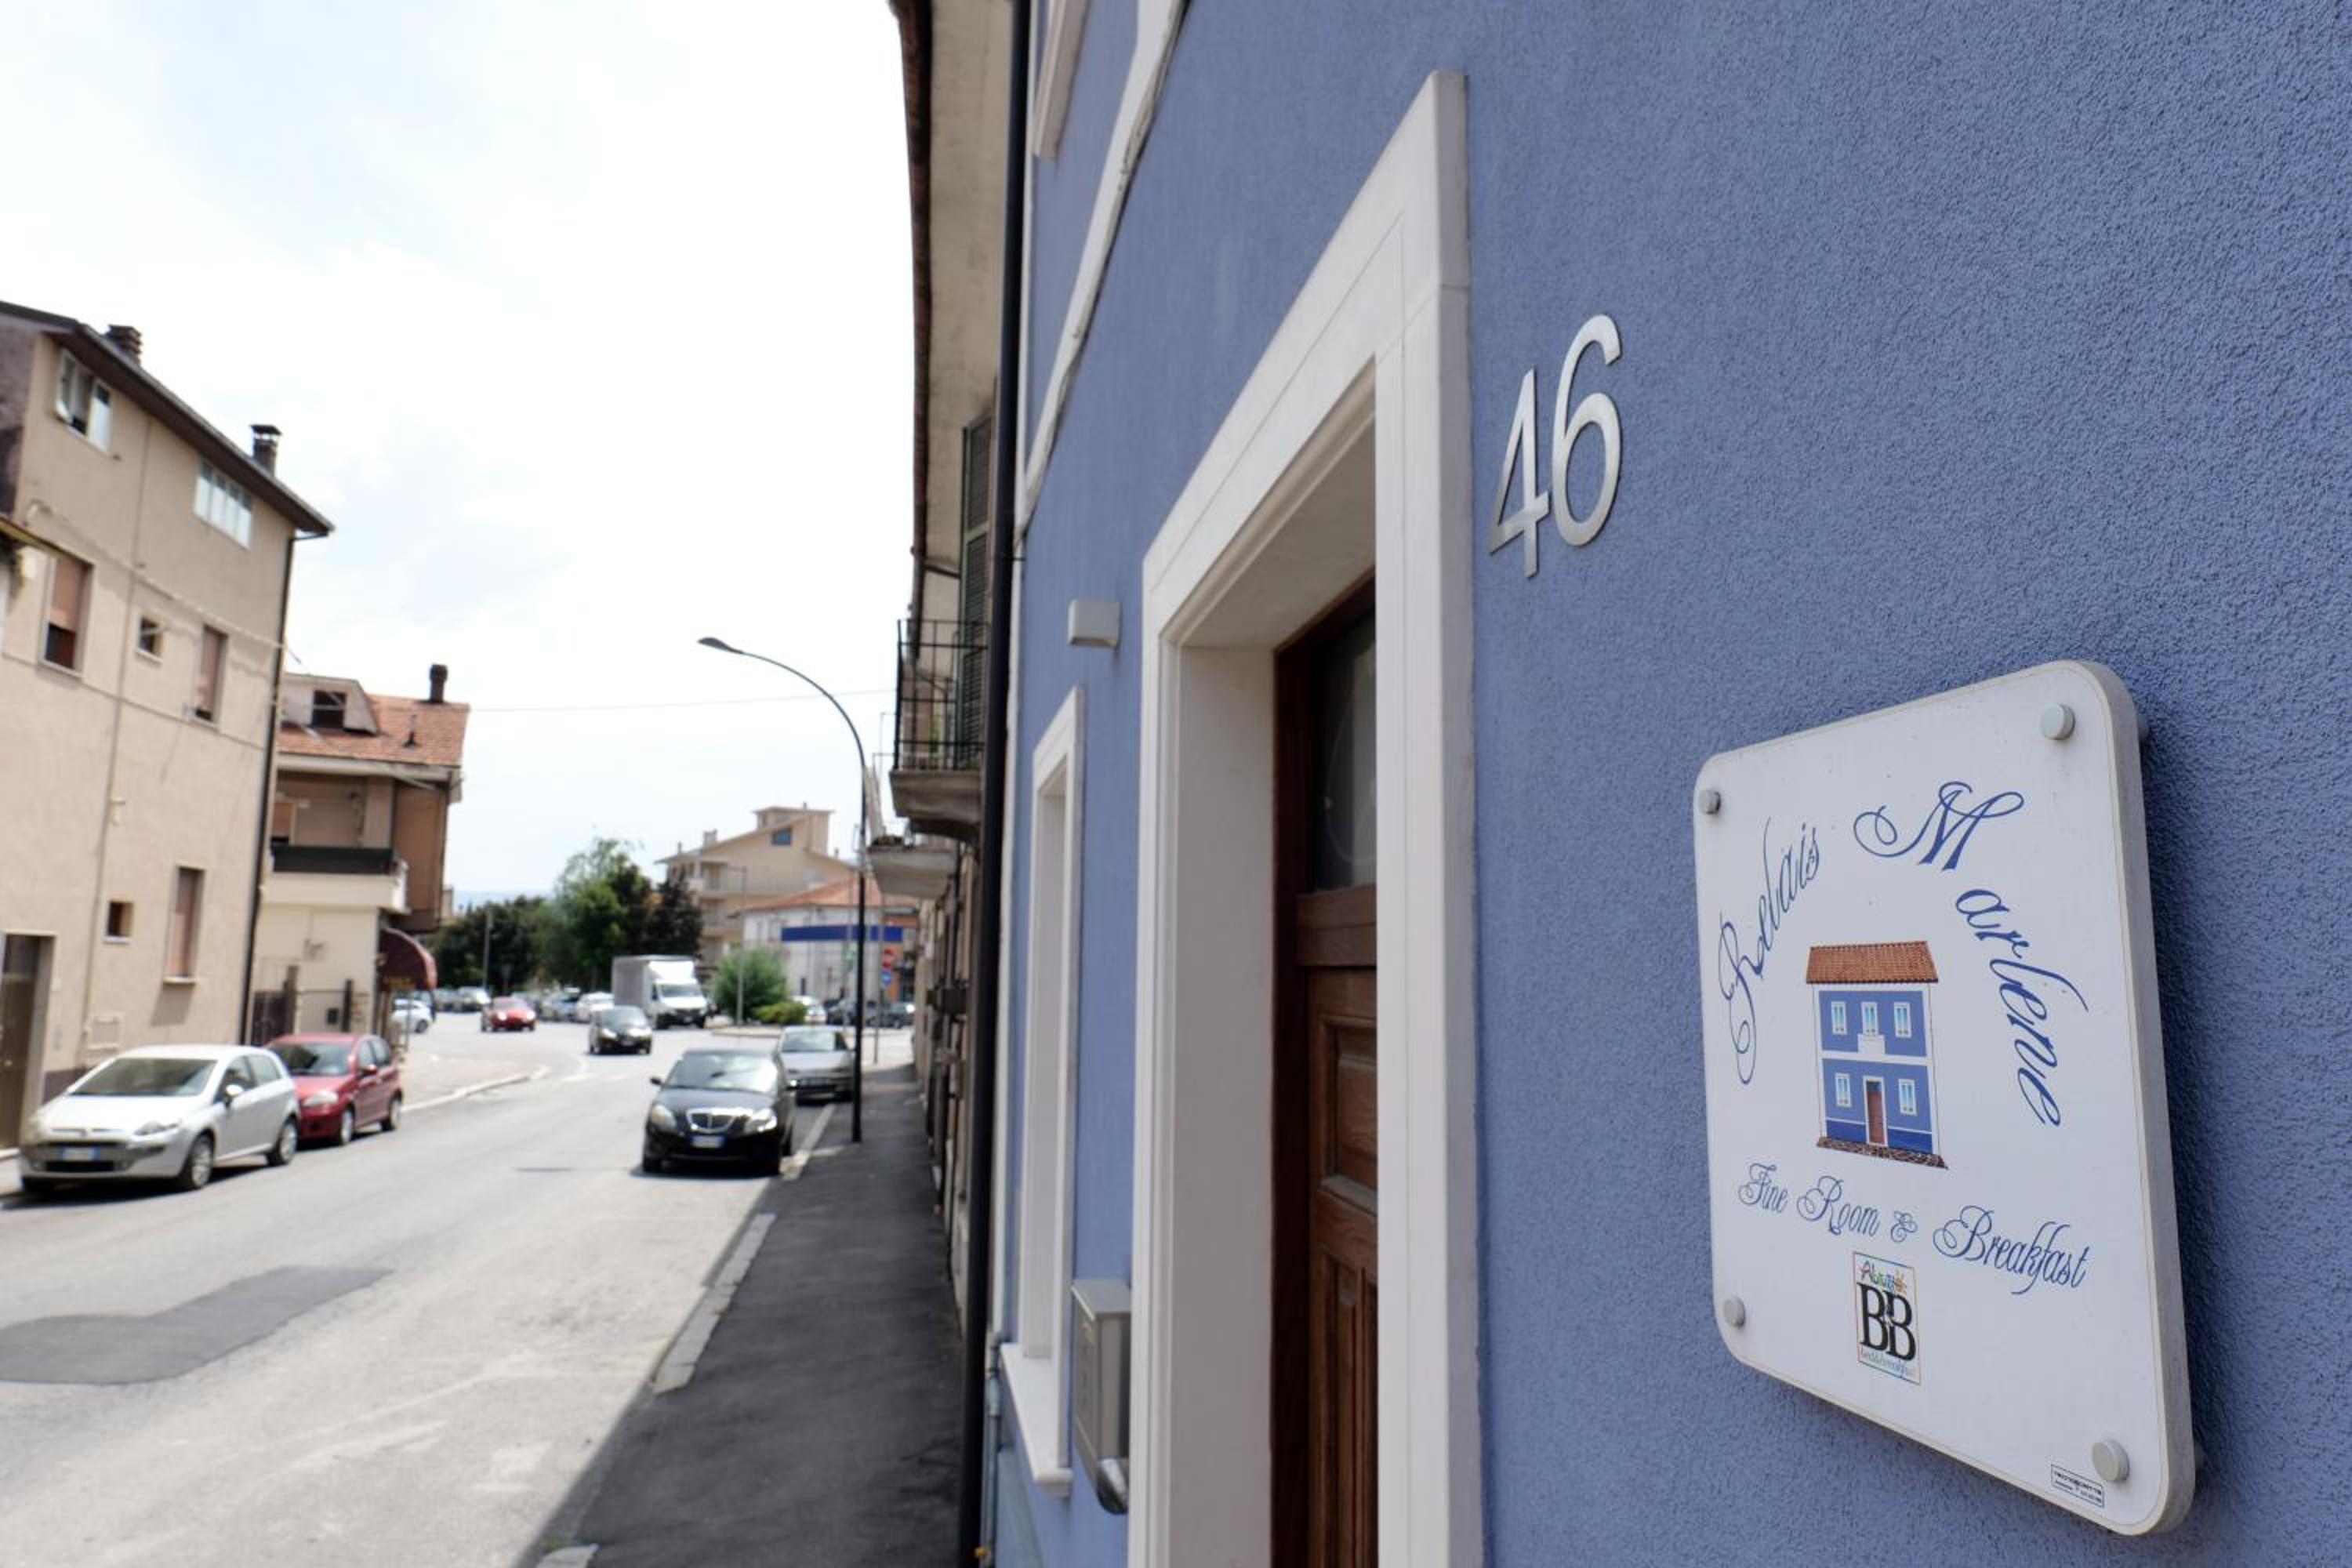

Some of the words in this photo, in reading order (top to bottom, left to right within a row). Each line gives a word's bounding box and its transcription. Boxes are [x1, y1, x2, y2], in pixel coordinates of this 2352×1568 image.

[1487, 313, 1623, 579] 46
[1718, 816, 1820, 1085] Relais
[1853, 781, 2089, 1127] Marlene
[1738, 1163, 1789, 1214] Fine
[1796, 1175, 1881, 1236] Room
[1889, 1210, 1918, 1243] &
[1933, 1204, 2091, 1295] Breakfast
